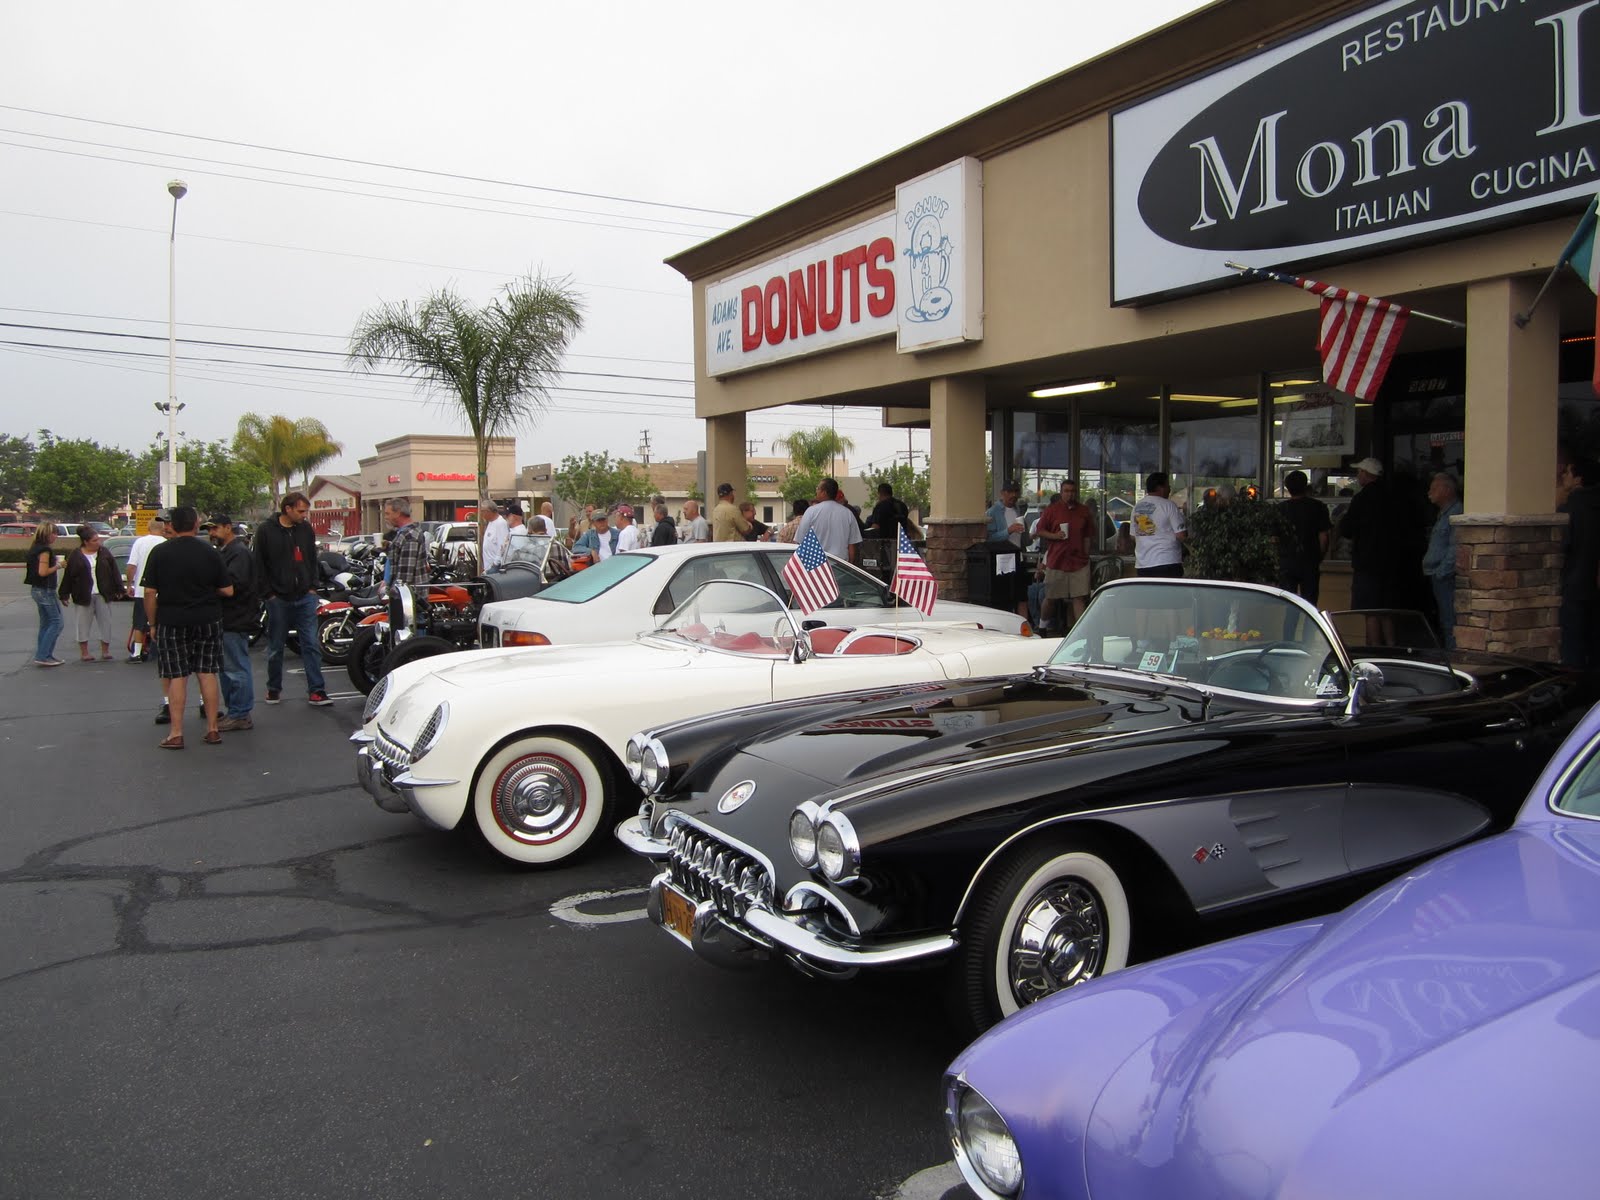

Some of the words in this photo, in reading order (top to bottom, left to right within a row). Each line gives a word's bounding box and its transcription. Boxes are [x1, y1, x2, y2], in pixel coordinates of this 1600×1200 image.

[1190, 99, 1477, 231] Mona
[1335, 187, 1432, 232] ITALIAN
[1470, 147, 1597, 200] CUCINA
[904, 195, 950, 230] DONUT
[921, 255, 930, 277] 4
[741, 236, 895, 353] DONUTS
[711, 297, 738, 325] ADAMS
[716, 330, 734, 354] AVE.
[1147, 655, 1161, 667] 59
